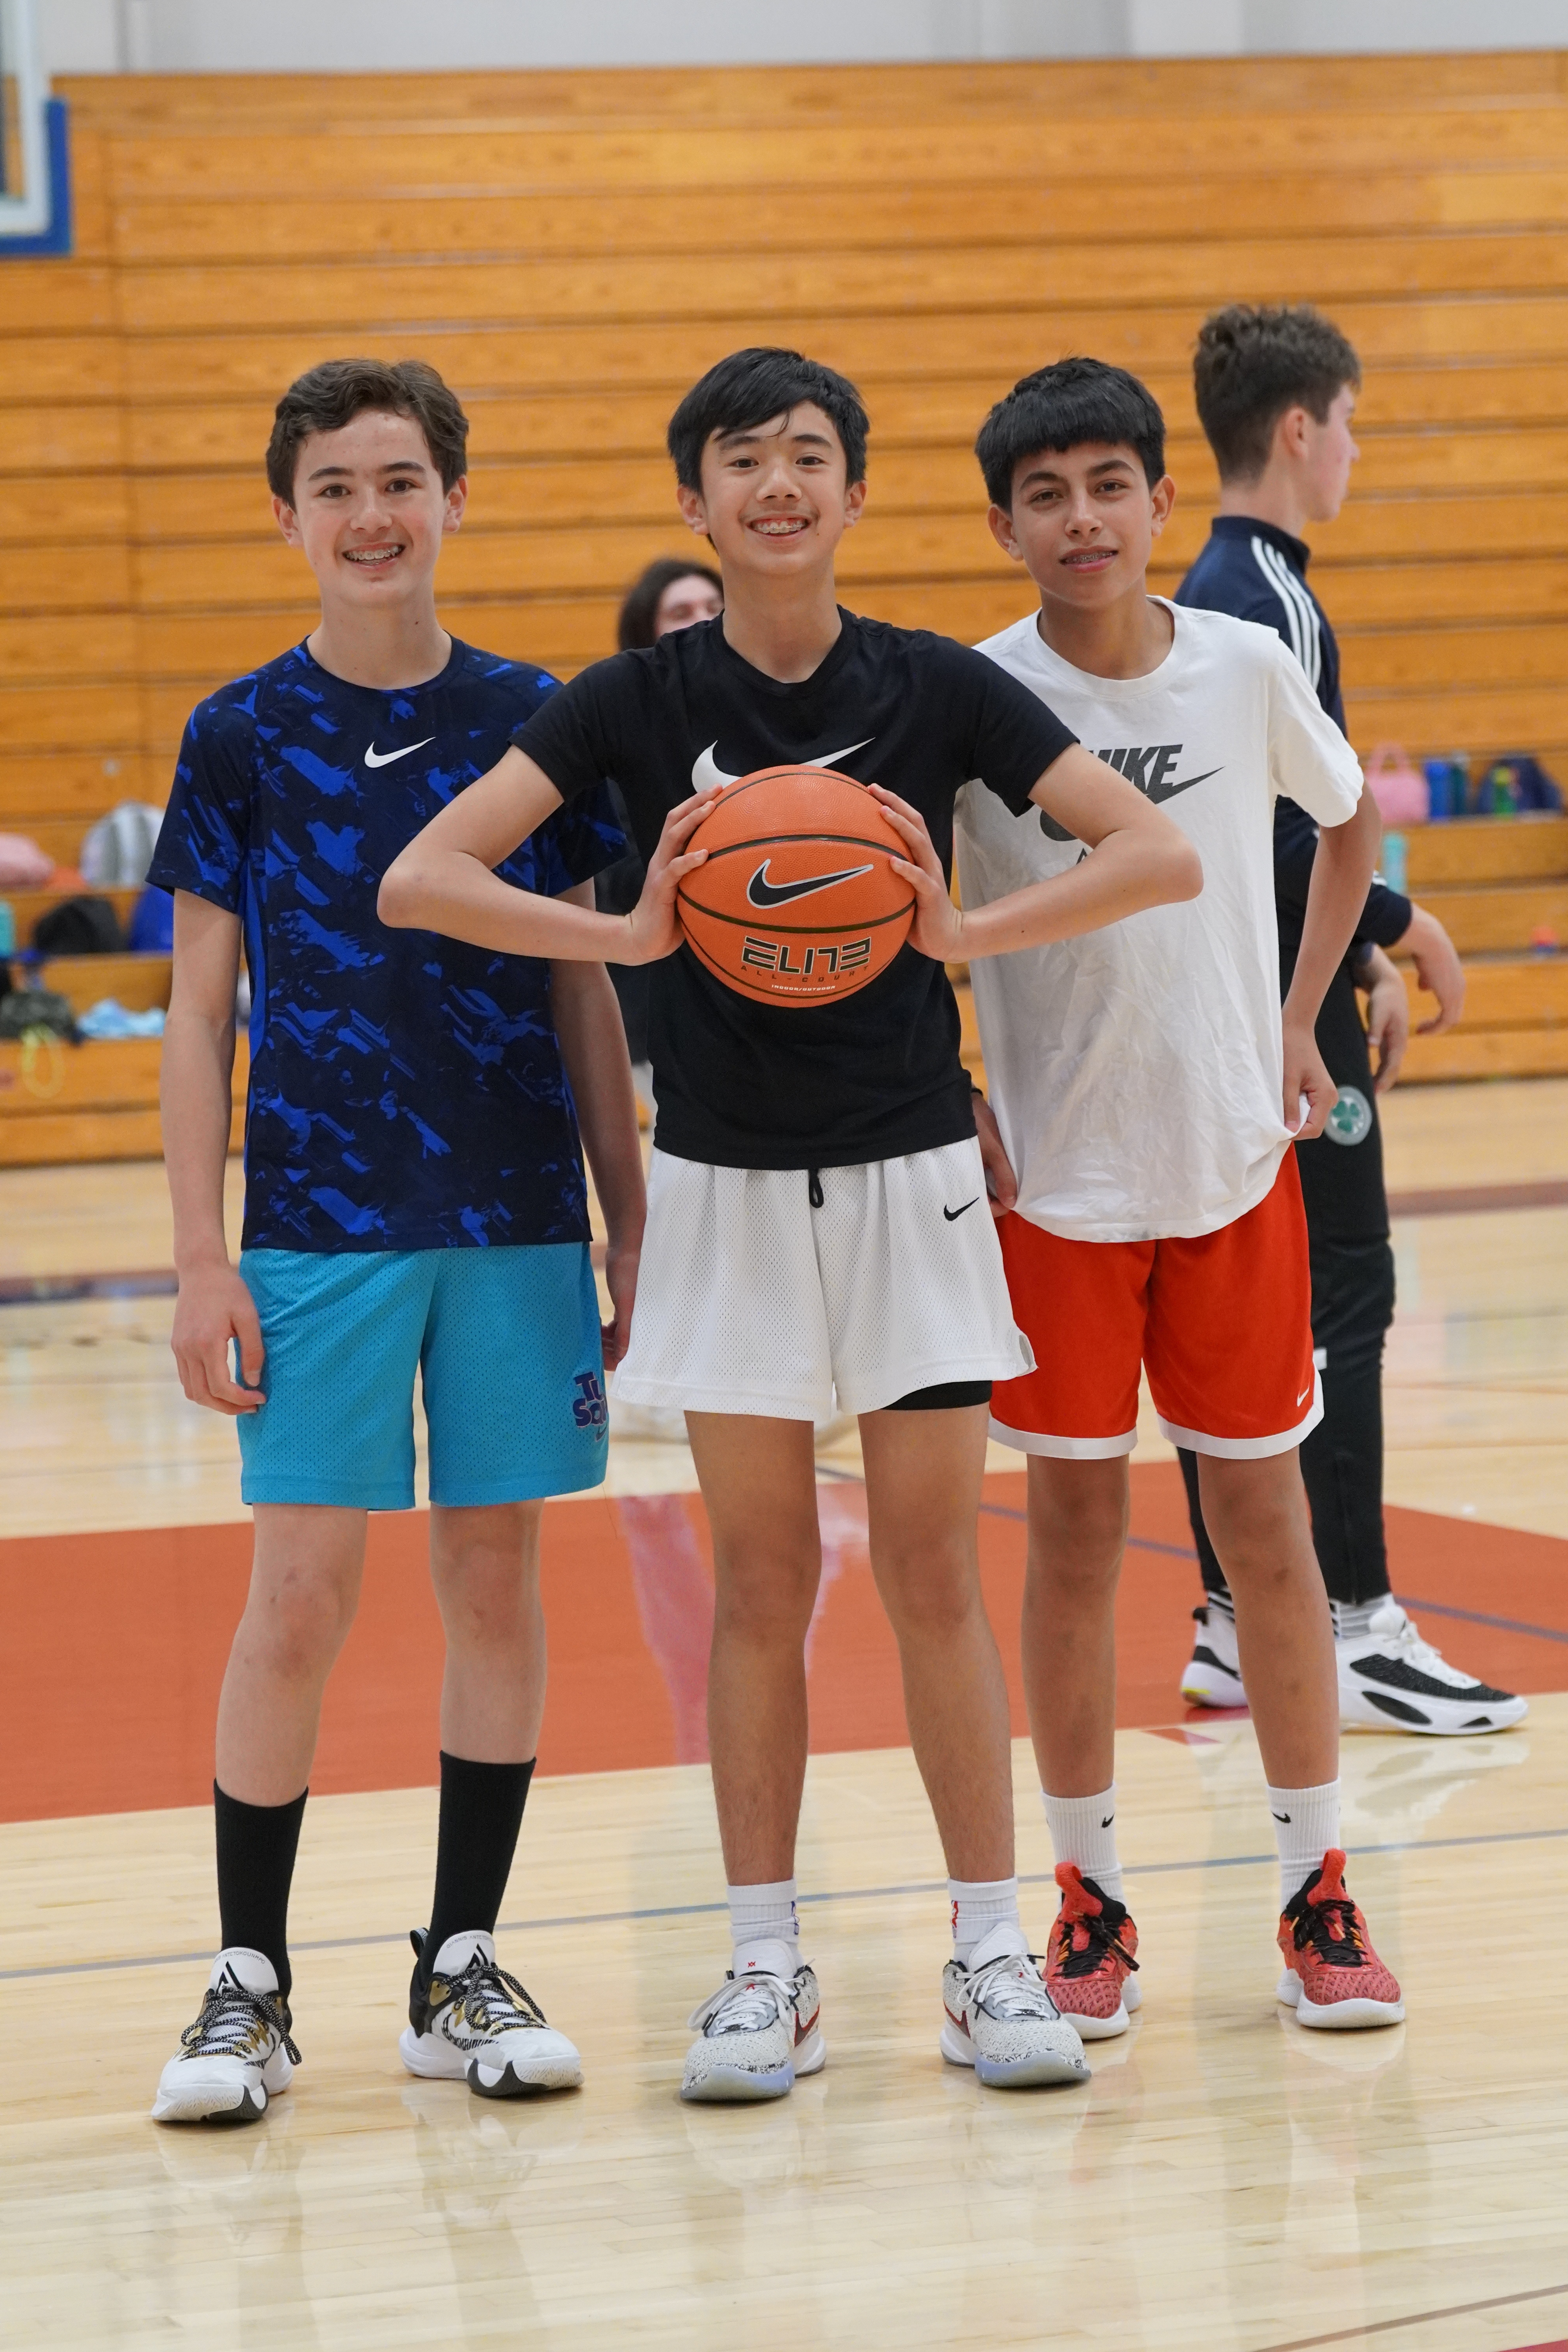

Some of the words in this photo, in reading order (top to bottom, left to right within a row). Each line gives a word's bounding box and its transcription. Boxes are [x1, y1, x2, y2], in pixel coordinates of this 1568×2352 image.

[1087, 744, 1183, 793] IKE
[740, 965, 869, 982] ALL-COURT
[741, 935, 871, 975] ELITE
